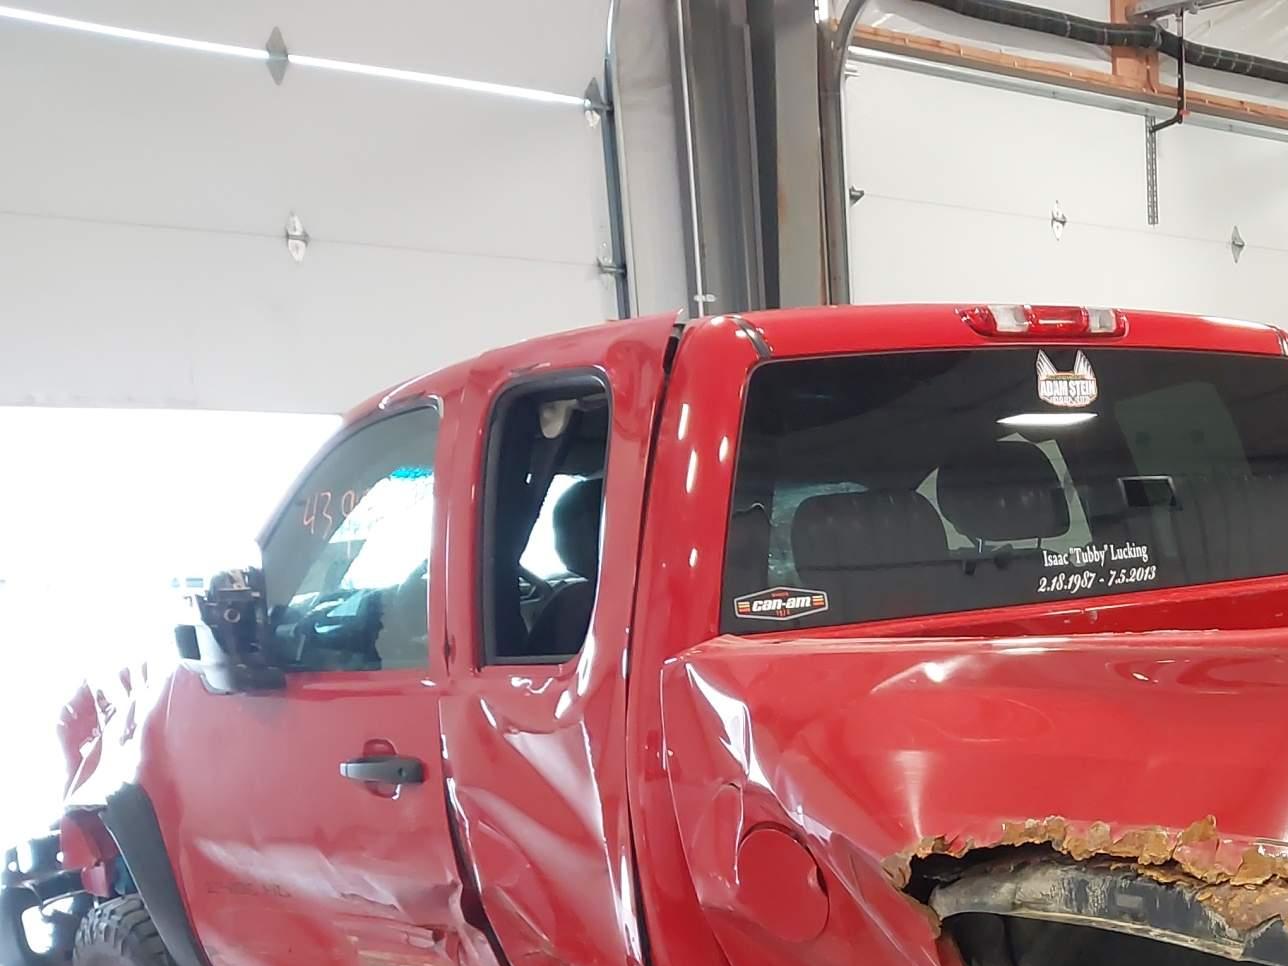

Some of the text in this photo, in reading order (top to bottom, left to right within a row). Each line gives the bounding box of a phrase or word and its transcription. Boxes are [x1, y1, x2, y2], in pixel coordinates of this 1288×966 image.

[1040, 380, 1097, 397] ADAM STEIN
[1042, 541, 1149, 567] Isaac "Tubby" Lucking
[1037, 570, 1096, 594] 2.18.1987
[1107, 565, 1157, 587] 7.5.2013
[752, 596, 811, 612] can-am
